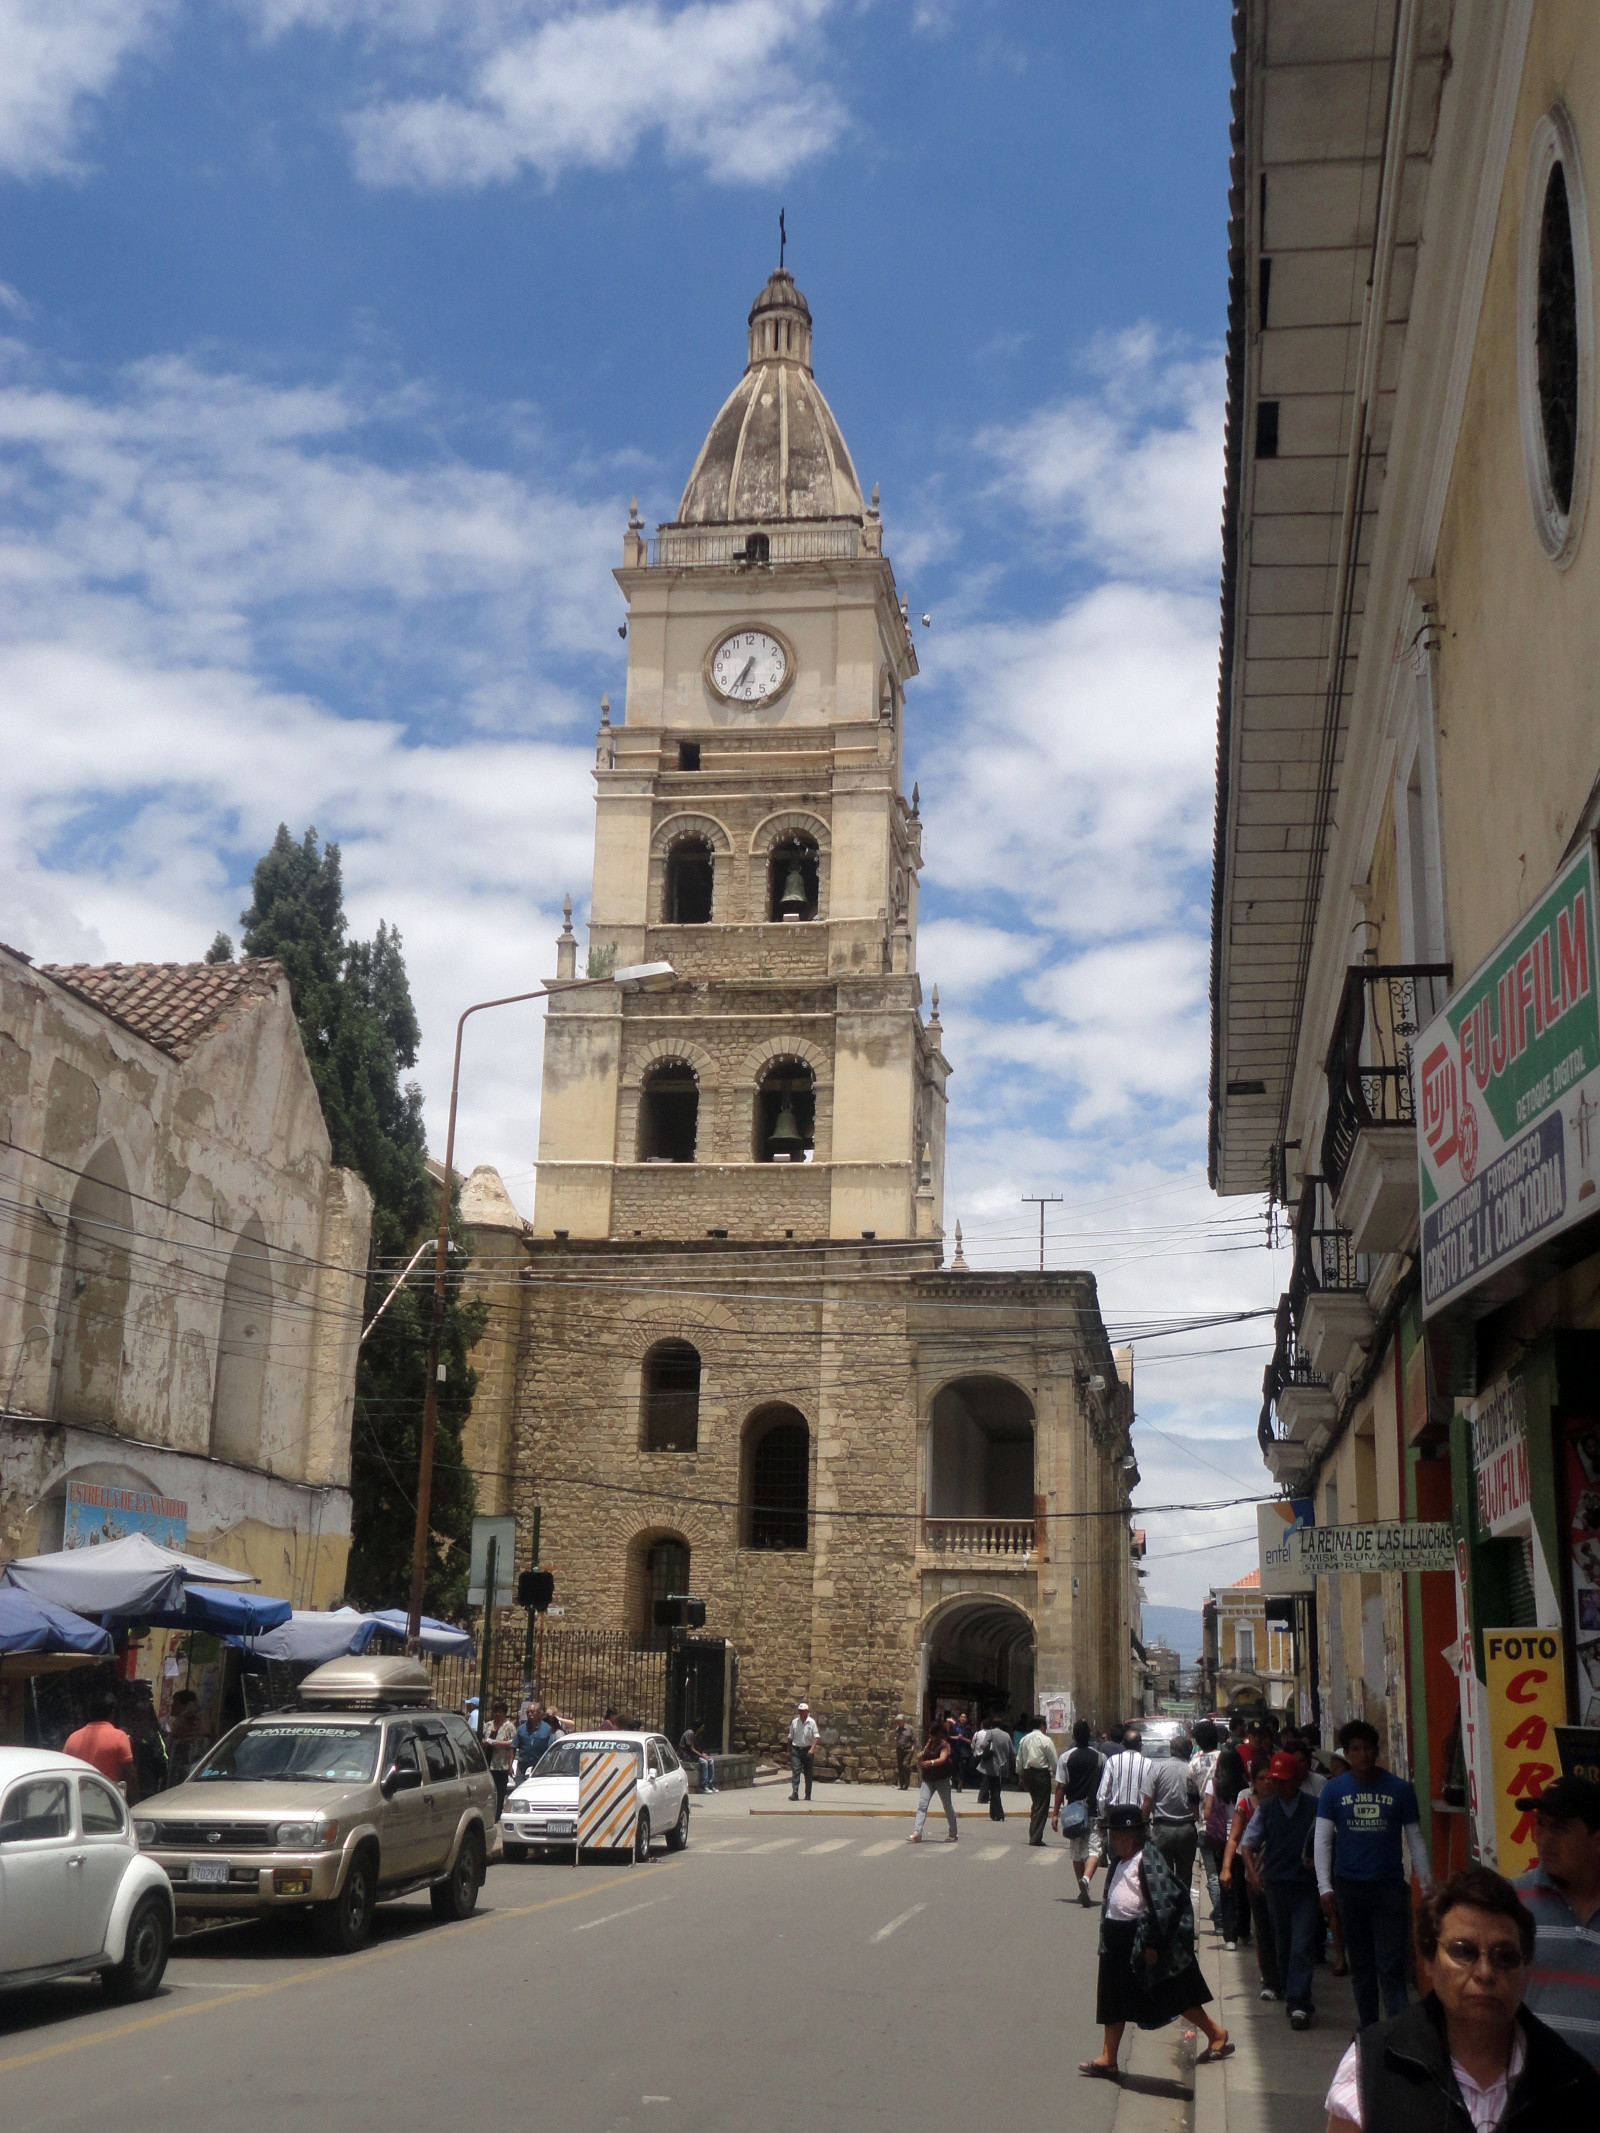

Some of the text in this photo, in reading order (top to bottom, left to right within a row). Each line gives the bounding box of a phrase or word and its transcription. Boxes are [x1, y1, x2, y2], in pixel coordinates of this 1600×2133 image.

[732, 640, 740, 649] 11
[745, 635, 755, 645] 12
[762, 638, 766, 648] 1
[721, 649, 731, 659] 10
[771, 646, 778, 656] 2
[716, 662, 724, 672] 9
[775, 660, 782, 670] 3
[720, 675, 728, 685] 8
[769, 673, 777, 683] 4
[733, 685, 740, 694] 7
[744, 687, 752, 696] 6
[758, 683, 766, 693] 5
[1458, 887, 1592, 1101] FUJIFILM
[1516, 1073, 1551, 1124] RETOQUE
[1552, 1045, 1586, 1093] DIGITAL
[1421, 1041, 1458, 1169] FUJI
[1463, 1122, 1473, 1162] 20
[1437, 1180, 1482, 1238] LABORATORIO
[1486, 1131, 1541, 1200] FOTOGRAFICO
[1426, 1231, 1458, 1299] CRISTO
[1459, 1218, 1474, 1277] DE
[1477, 1205, 1493, 1266] LA
[1494, 1152, 1563, 1252] CONCORDIA
[1477, 1440, 1531, 1529] FUJIFILM
[69, 1481, 188, 1519] ESTRELLA DE LA NAVIDAD
[1301, 1527, 1451, 1554] LA REINA DE LAS LLAUCHAS
[1265, 1543, 1291, 1564] entel
[1343, 1552, 1396, 1562] SUMAJ
[1304, 1560, 1363, 1571] SIEMPRE
[1369, 1561, 1387, 1569] LA
[1488, 1636, 1558, 1661] FOTO
[261, 1727, 346, 1736] PATHFINDER
[575, 1741, 617, 1750] STARLET
[1341, 1794, 1354, 1806] JK
[1375, 1793, 1394, 1805] LTD
